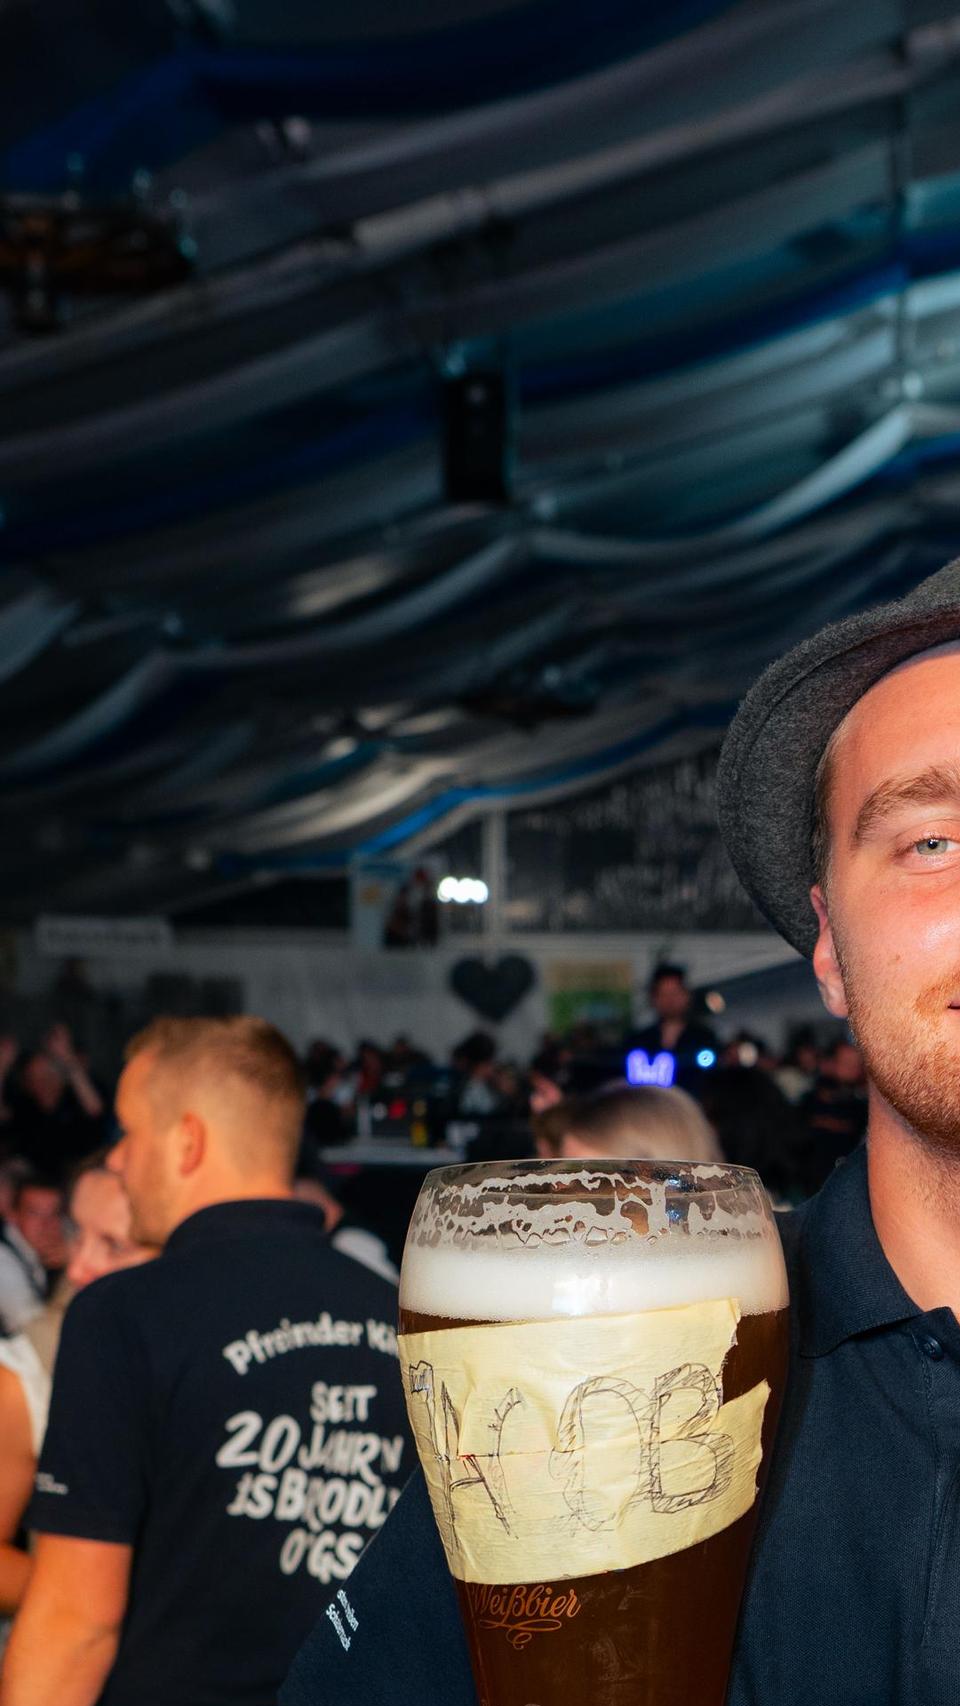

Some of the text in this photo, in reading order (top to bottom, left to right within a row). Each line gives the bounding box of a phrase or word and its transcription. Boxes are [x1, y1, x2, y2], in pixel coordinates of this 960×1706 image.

[310, 1380, 377, 1424] SEIT
[215, 1410, 302, 1475] 20
[471, 1585, 582, 1624] Weißbier
